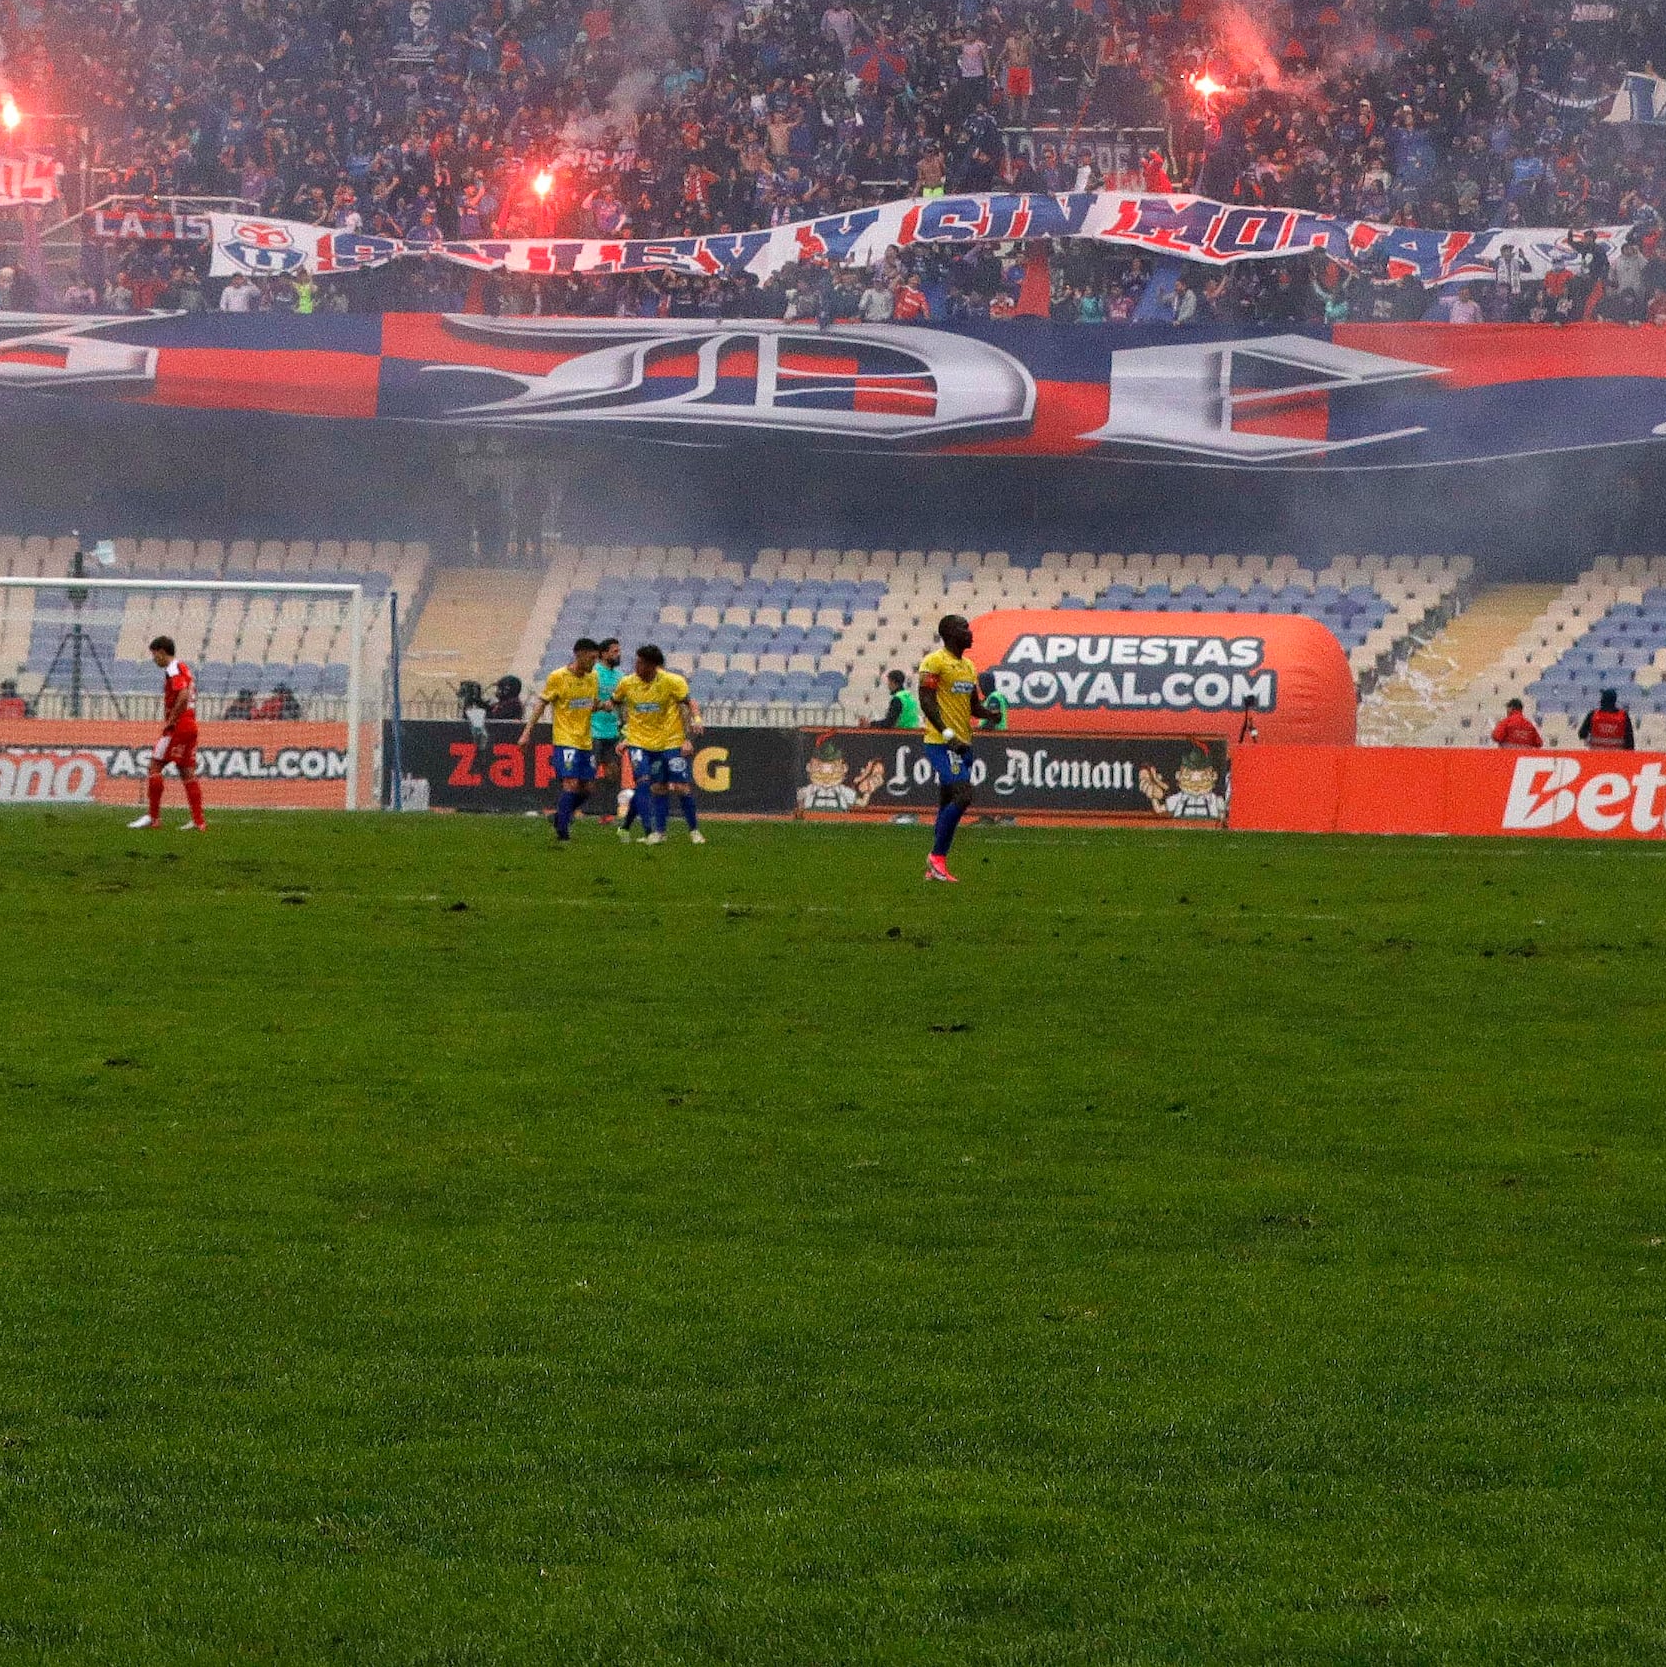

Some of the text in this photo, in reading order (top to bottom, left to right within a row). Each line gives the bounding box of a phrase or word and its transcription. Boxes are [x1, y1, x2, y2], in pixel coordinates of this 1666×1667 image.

[898, 193, 1099, 245] SIN
[1007, 636, 1260, 668] APUESTAS
[993, 671, 1273, 707] ROYAL.COM
[994, 747, 1135, 795] Aleman
